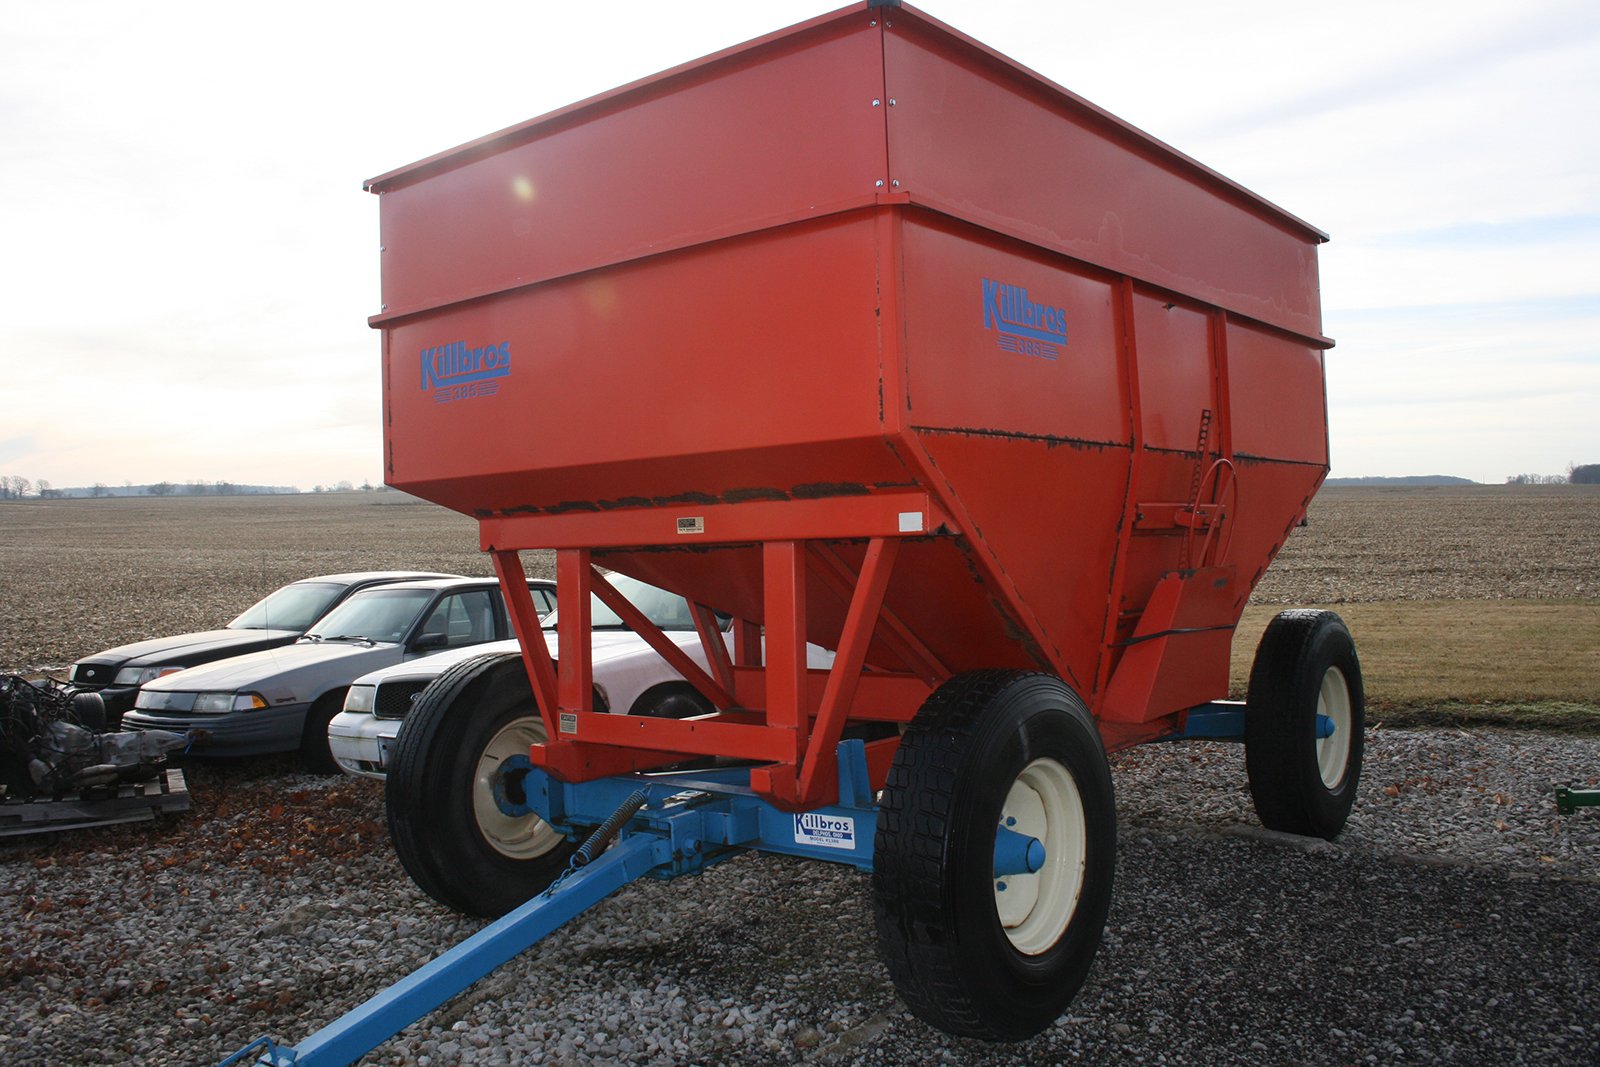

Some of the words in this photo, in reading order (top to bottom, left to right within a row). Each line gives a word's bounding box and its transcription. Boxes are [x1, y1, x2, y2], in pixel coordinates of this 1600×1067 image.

[982, 277, 1067, 336] Killbros
[421, 340, 511, 391] Killbros
[453, 384, 478, 401] 385
[795, 813, 849, 834] Killbros
